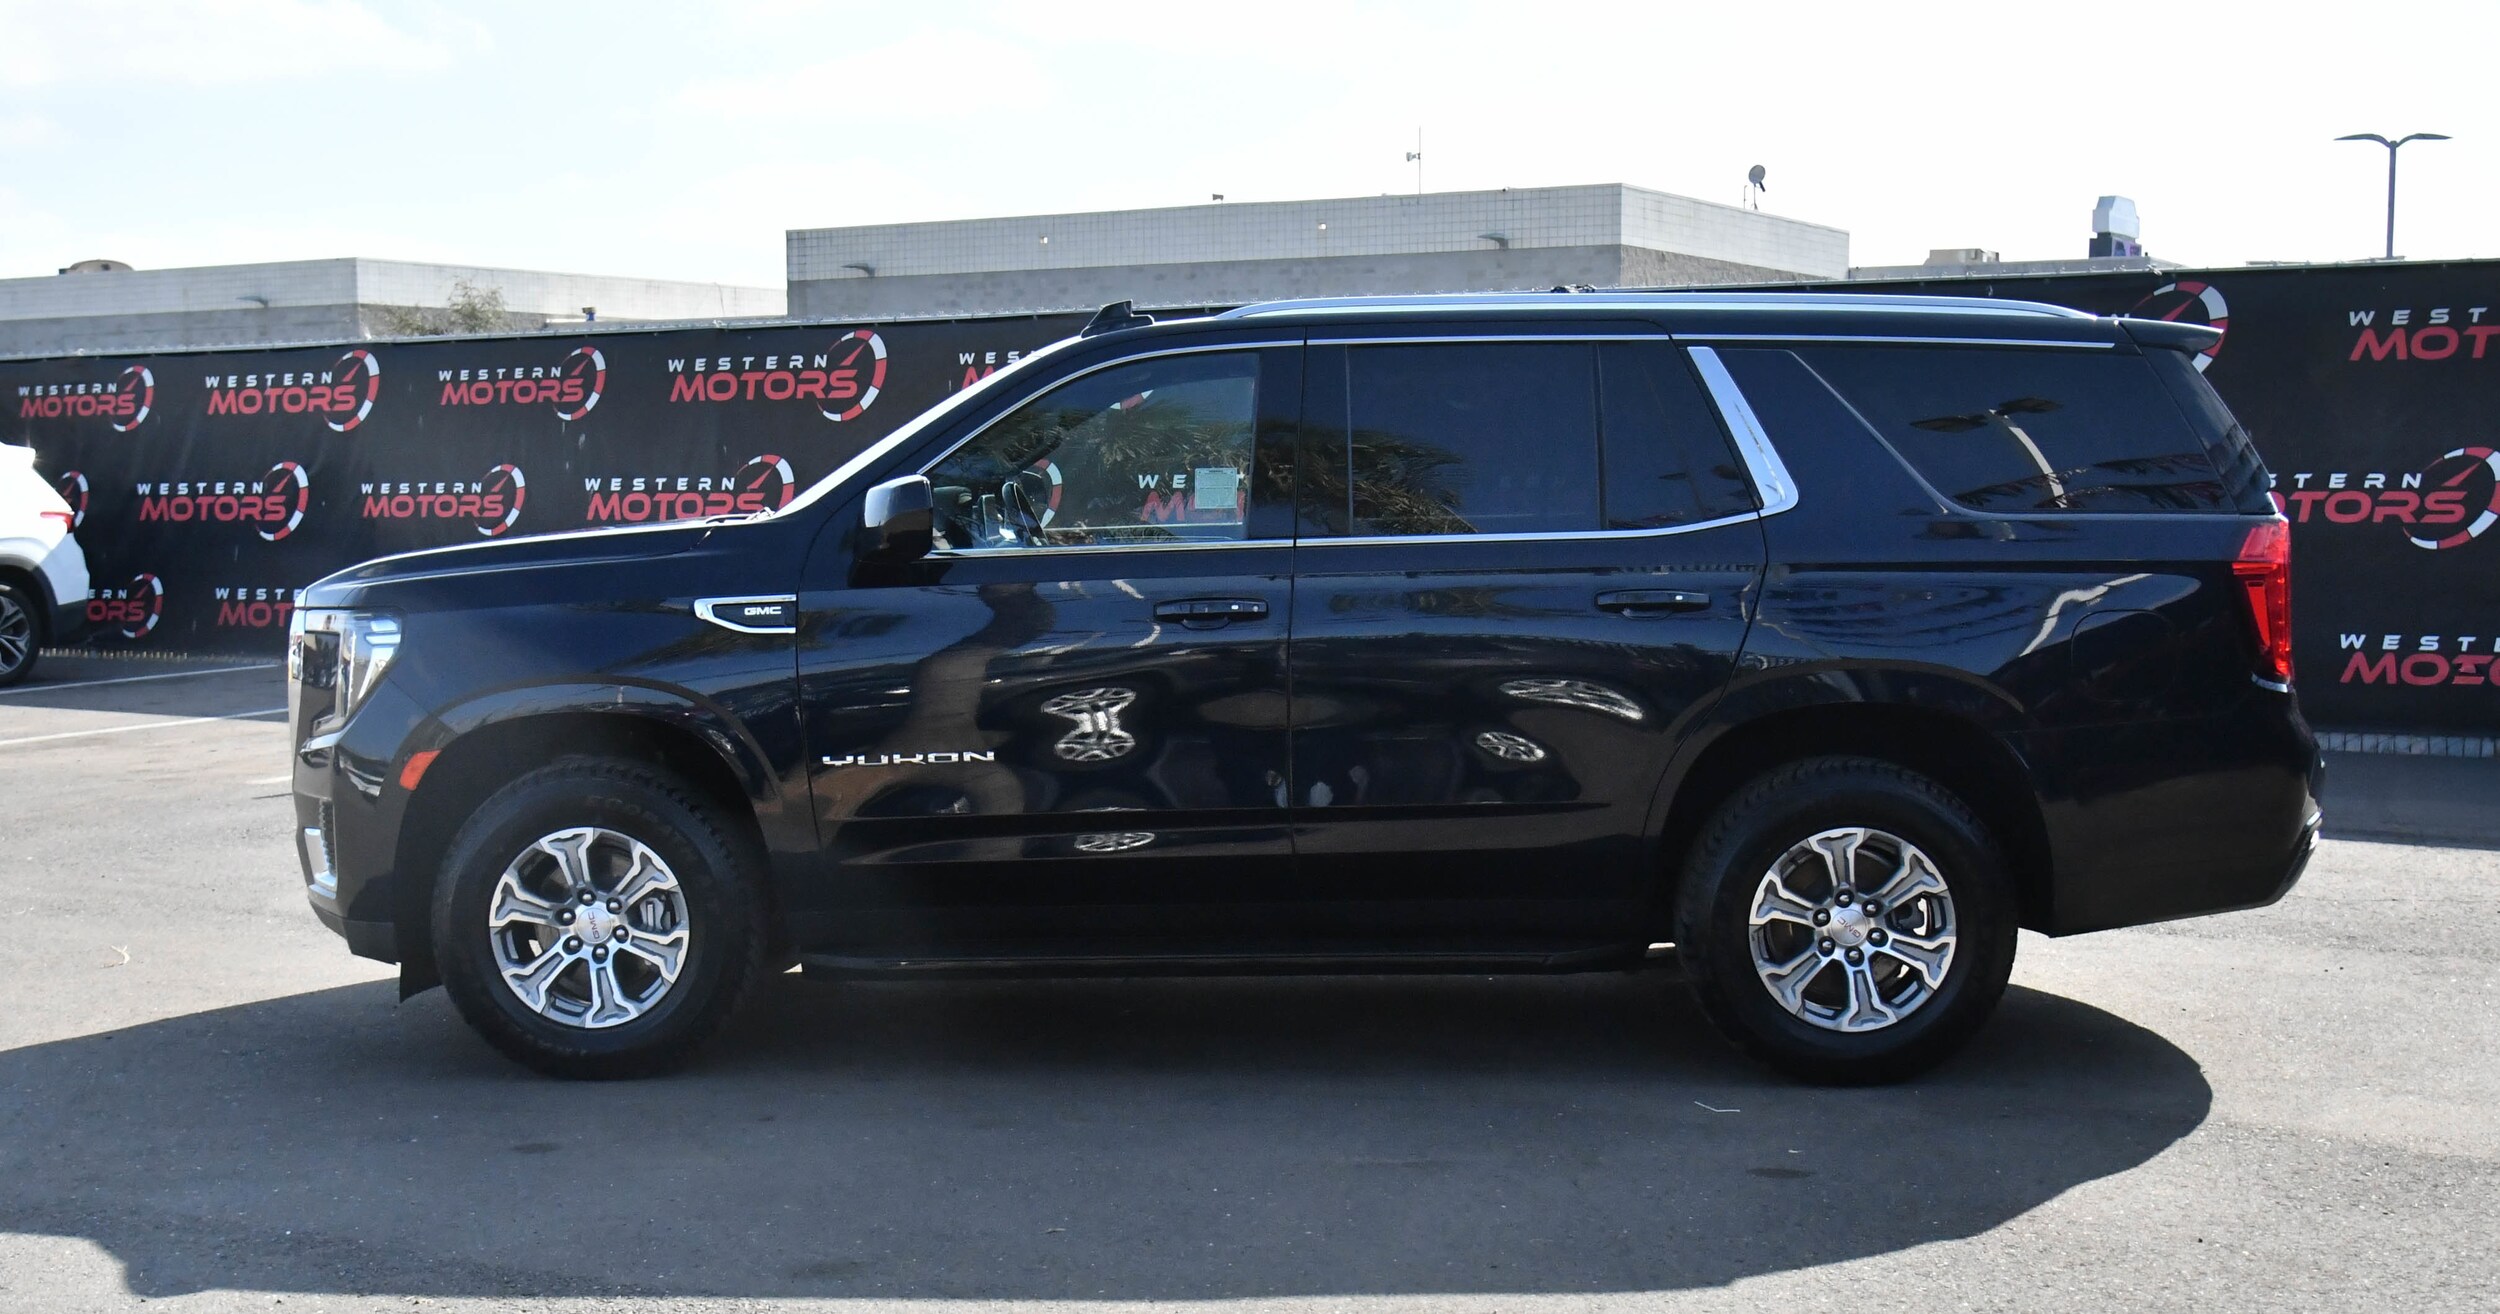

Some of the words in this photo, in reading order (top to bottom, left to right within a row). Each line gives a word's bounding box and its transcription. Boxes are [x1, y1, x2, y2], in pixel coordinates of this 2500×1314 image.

[668, 354, 828, 372] WESTERN
[205, 371, 333, 388] WESTERN
[438, 366, 562, 381] WESTERN
[18, 383, 117, 396] WESTERN
[441, 378, 584, 405] MOTORS
[670, 369, 858, 402] MOTORS
[20, 393, 135, 418] MOTORS
[207, 385, 356, 415] MOTORS
[137, 481, 264, 495] WESTERN
[361, 482, 483, 495] WESTERN
[584, 477, 736, 491] WESTERN
[139, 495, 287, 521] MOTORS
[362, 494, 504, 518] MOTORS
[587, 492, 766, 521] MOTORS
[743, 605, 782, 616] GMC
[822, 751, 995, 766] YUKON
[588, 911, 600, 939] GMC
[1837, 917, 1861, 938] GMC
